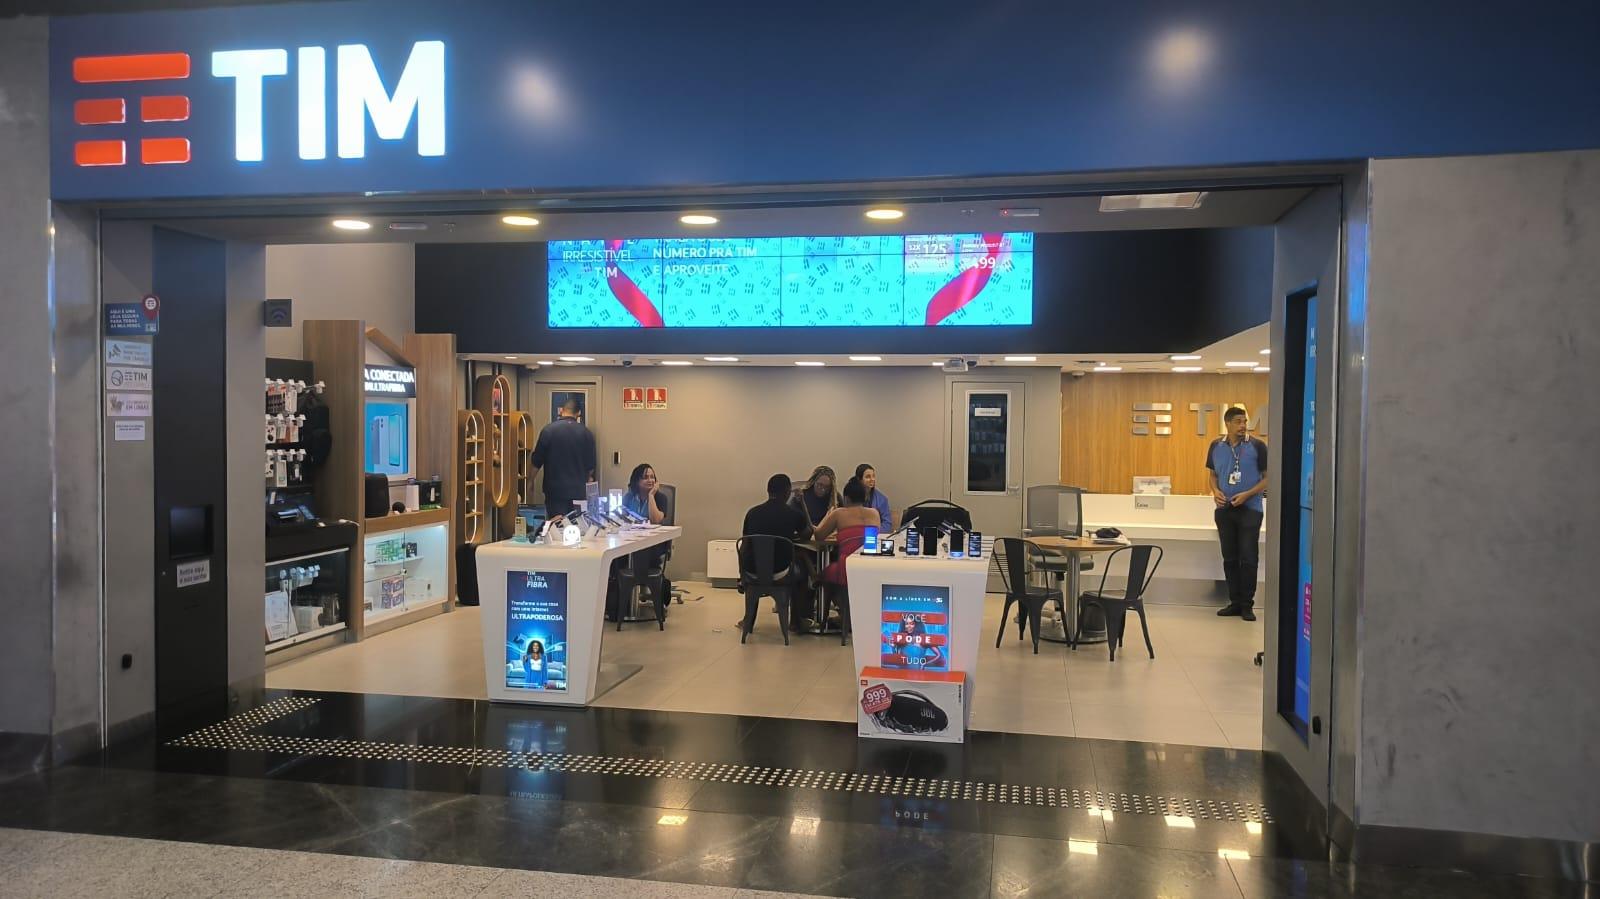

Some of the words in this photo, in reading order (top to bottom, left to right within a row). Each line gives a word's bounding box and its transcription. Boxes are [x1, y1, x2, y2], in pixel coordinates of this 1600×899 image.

[211, 41, 445, 161] TIM
[563, 248, 633, 262] IRRESISTÍVEL
[653, 246, 706, 259] NÚMERO
[709, 247, 733, 258] PRA
[735, 247, 757, 257] TIM
[595, 266, 618, 278] TIM
[652, 265, 660, 276] E
[664, 264, 729, 276] APROVEITE
[133, 372, 148, 381] TIM
[370, 369, 414, 382] CONECTADA
[511, 613, 564, 621] ULTRAPODEROSA
[896, 634, 931, 644] PODE
[901, 656, 927, 665] TUDO
[866, 688, 887, 703] 999
